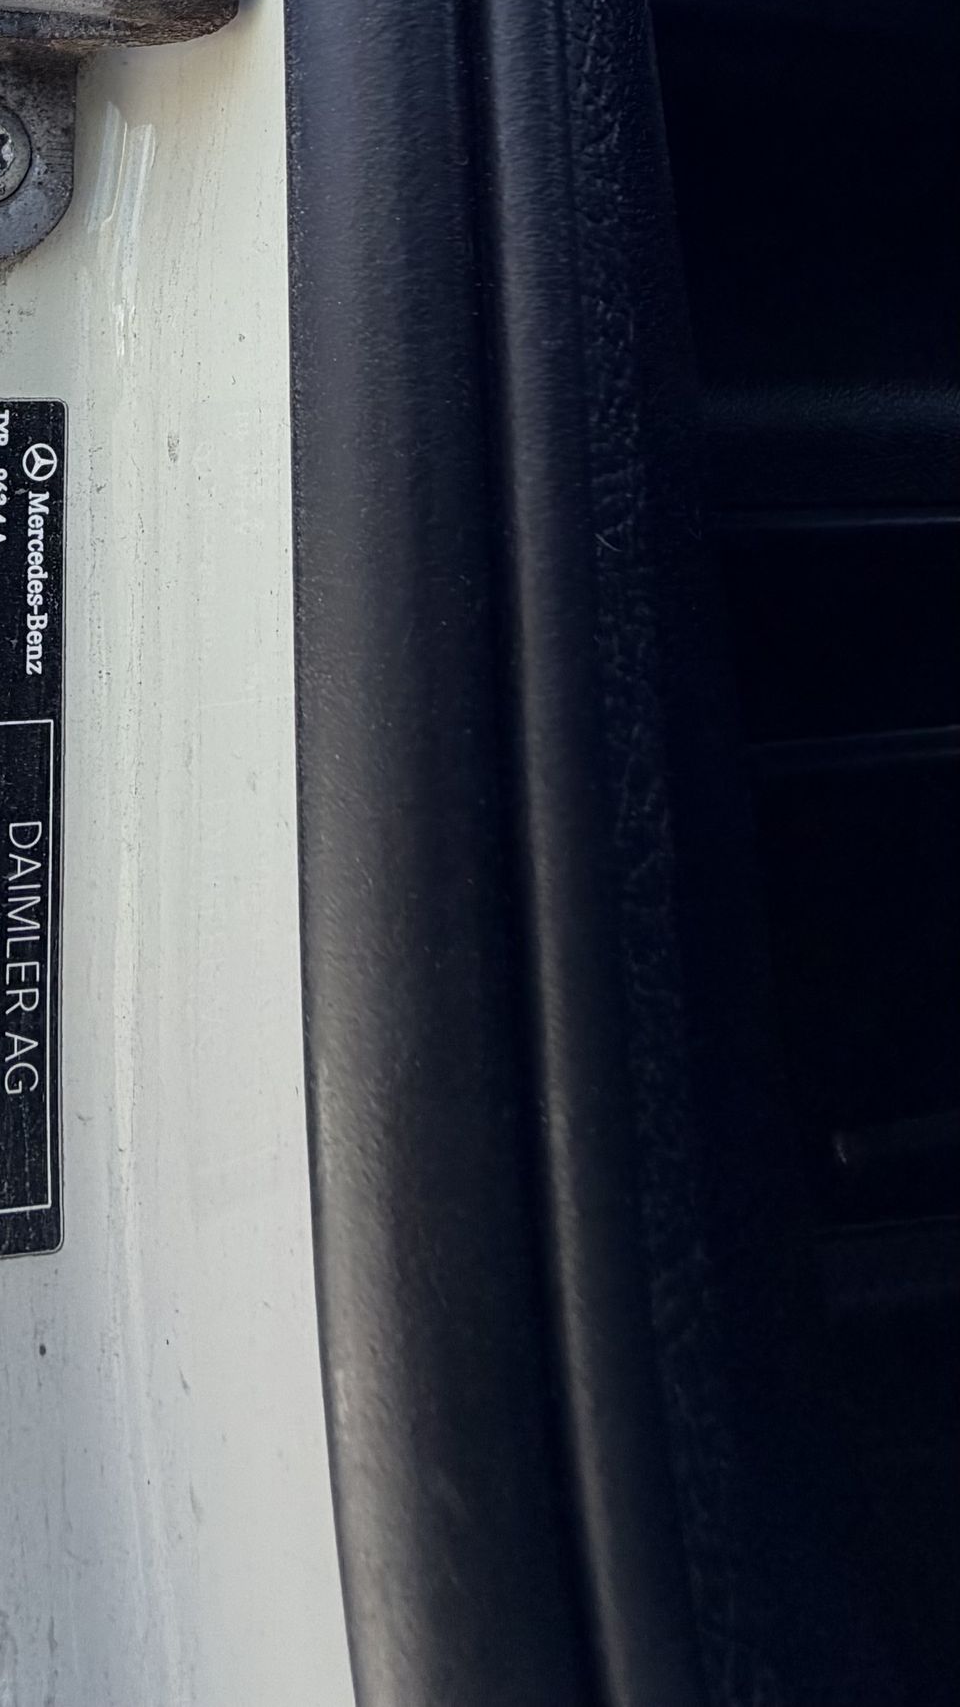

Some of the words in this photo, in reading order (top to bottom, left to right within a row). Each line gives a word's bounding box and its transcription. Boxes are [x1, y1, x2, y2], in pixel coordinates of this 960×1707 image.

[26, 491, 48, 675] Mercedes-Benz
[3, 821, 42, 1016] DAIMLER
[4, 1031, 38, 1095] AG
